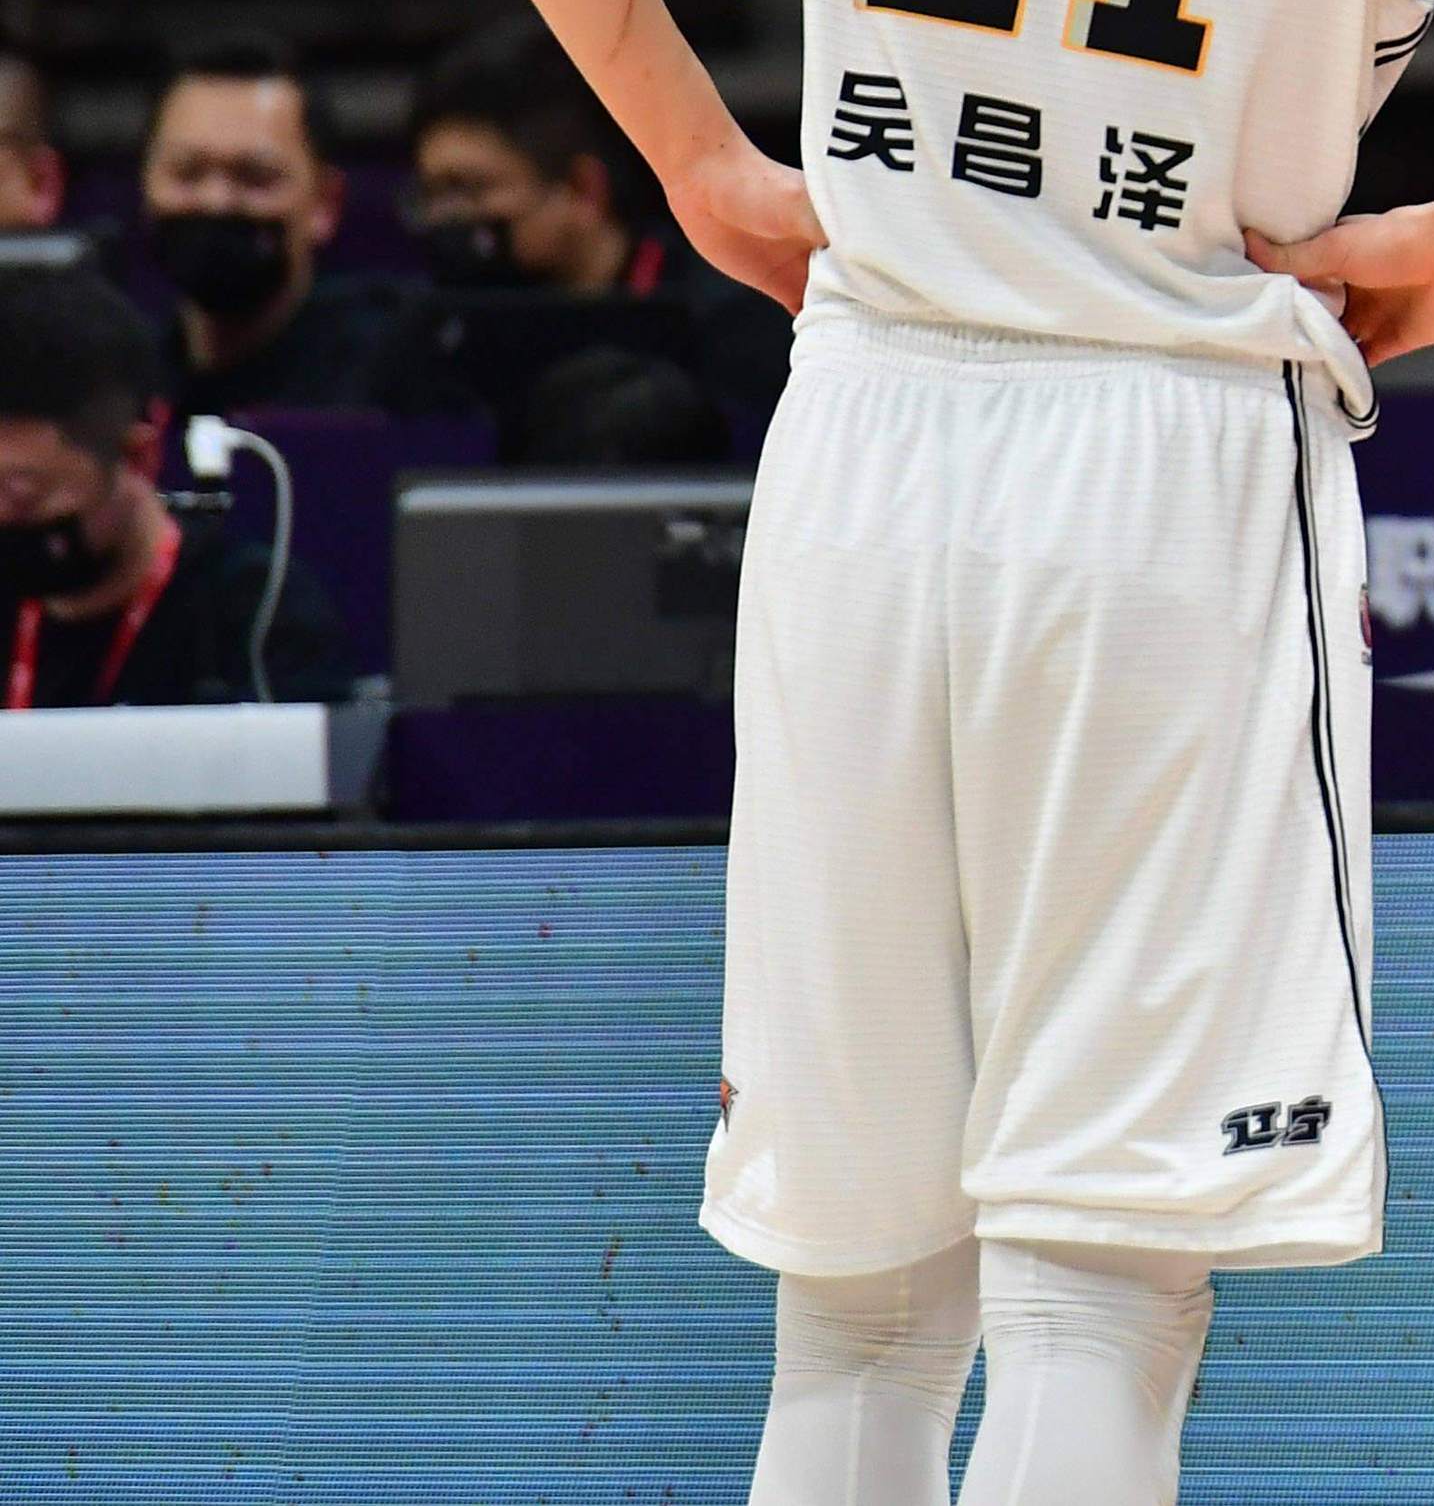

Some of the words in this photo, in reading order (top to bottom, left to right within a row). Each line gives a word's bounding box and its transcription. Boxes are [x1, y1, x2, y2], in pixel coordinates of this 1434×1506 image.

[827, 70, 1195, 231] 吴昌泽
[1220, 1094, 1332, 1156] 辽宁
